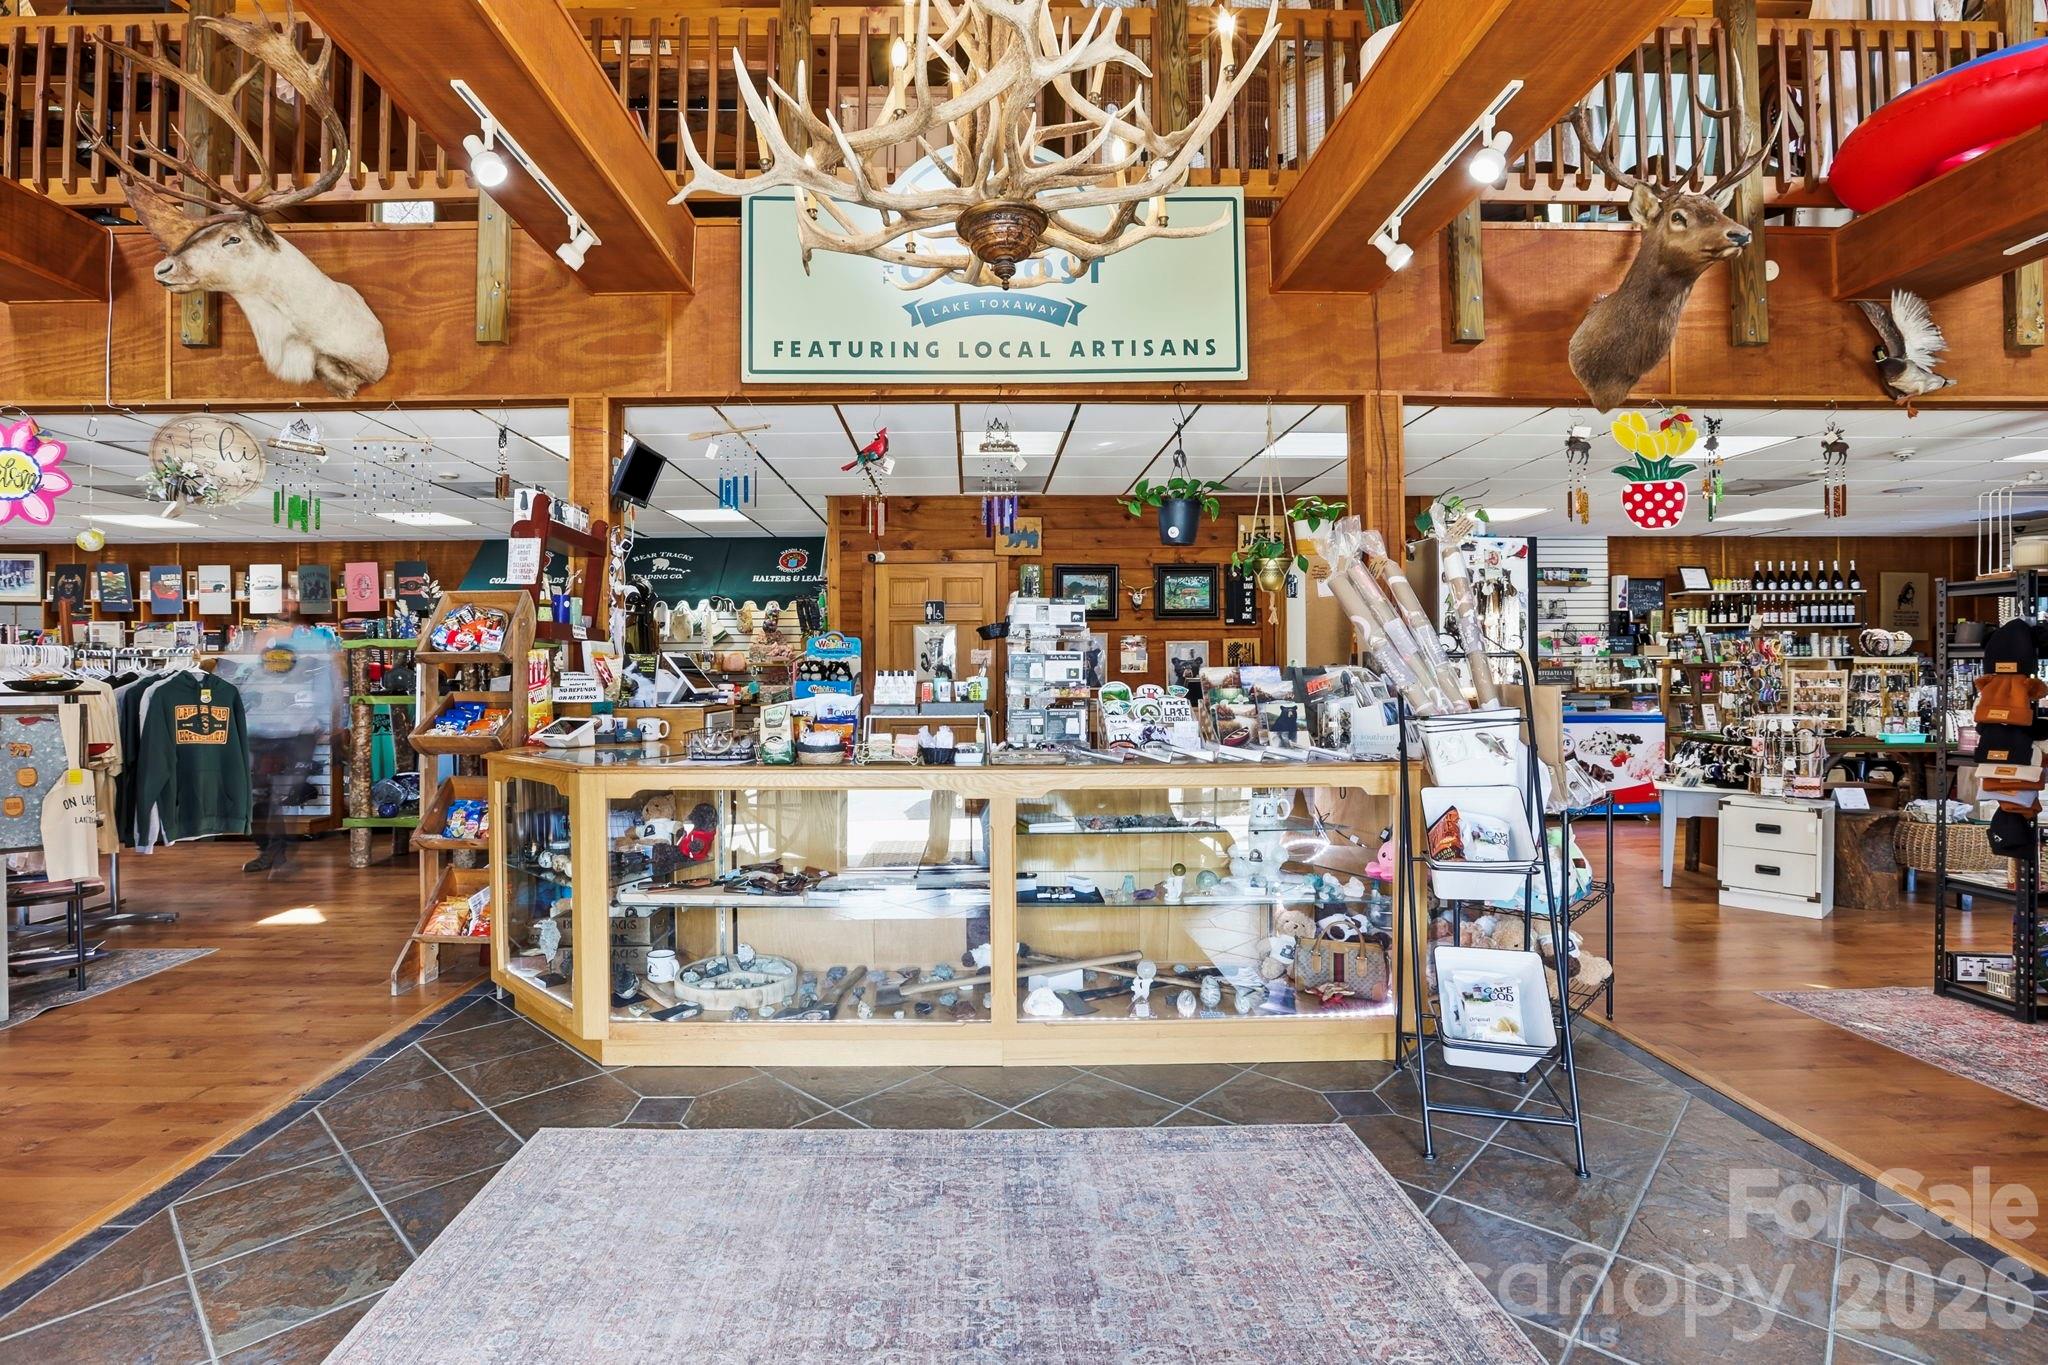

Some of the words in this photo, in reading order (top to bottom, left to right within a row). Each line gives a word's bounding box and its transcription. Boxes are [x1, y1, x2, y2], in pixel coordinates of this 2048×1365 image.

[931, 301, 971, 317] LAKE
[979, 299, 1059, 317] TOXAWAY
[773, 340, 940, 359] FEATURING
[958, 340, 1052, 359] LOCAL
[1069, 338, 1218, 358] ARTISANS
[62, 797, 77, 810] ON
[1483, 986, 1514, 994] CAPE
[1489, 993, 1515, 1002] COD
